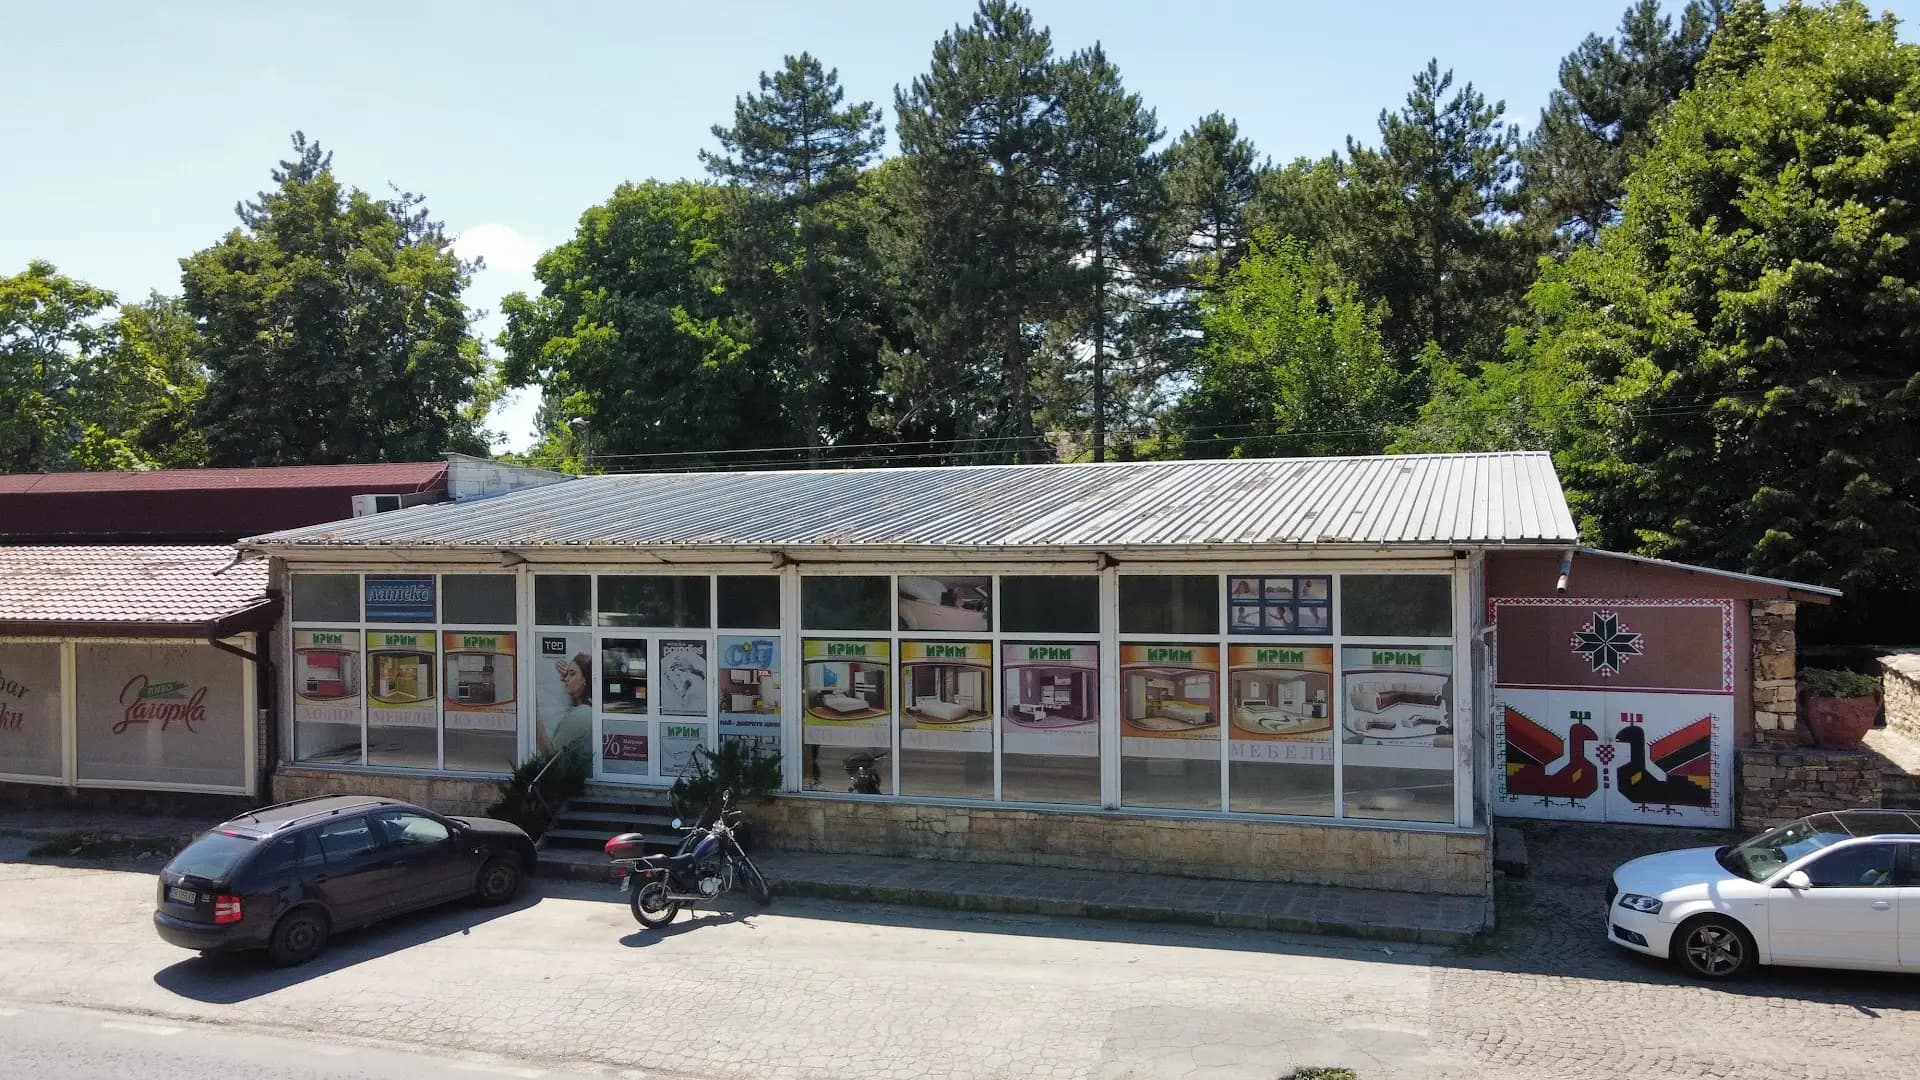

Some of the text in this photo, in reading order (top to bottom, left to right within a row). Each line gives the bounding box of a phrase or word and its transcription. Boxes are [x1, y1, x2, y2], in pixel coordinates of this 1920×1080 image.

[313, 633, 342, 644] ИРИМ
[385, 634, 417, 646] ИРИМ
[463, 636, 496, 648] ИРИМ
[827, 643, 866, 656] ИРИМ
[926, 645, 966, 657] ИРИМ
[1028, 647, 1071, 660] ИРИМ
[1147, 648, 1192, 662] ИРИМ
[1257, 649, 1304, 663] ИРИМ
[1372, 651, 1422, 665] ИРИМ
[667, 726, 700, 737] ИРИМ
[1230, 743, 1333, 761] МЕБЕЛИ
